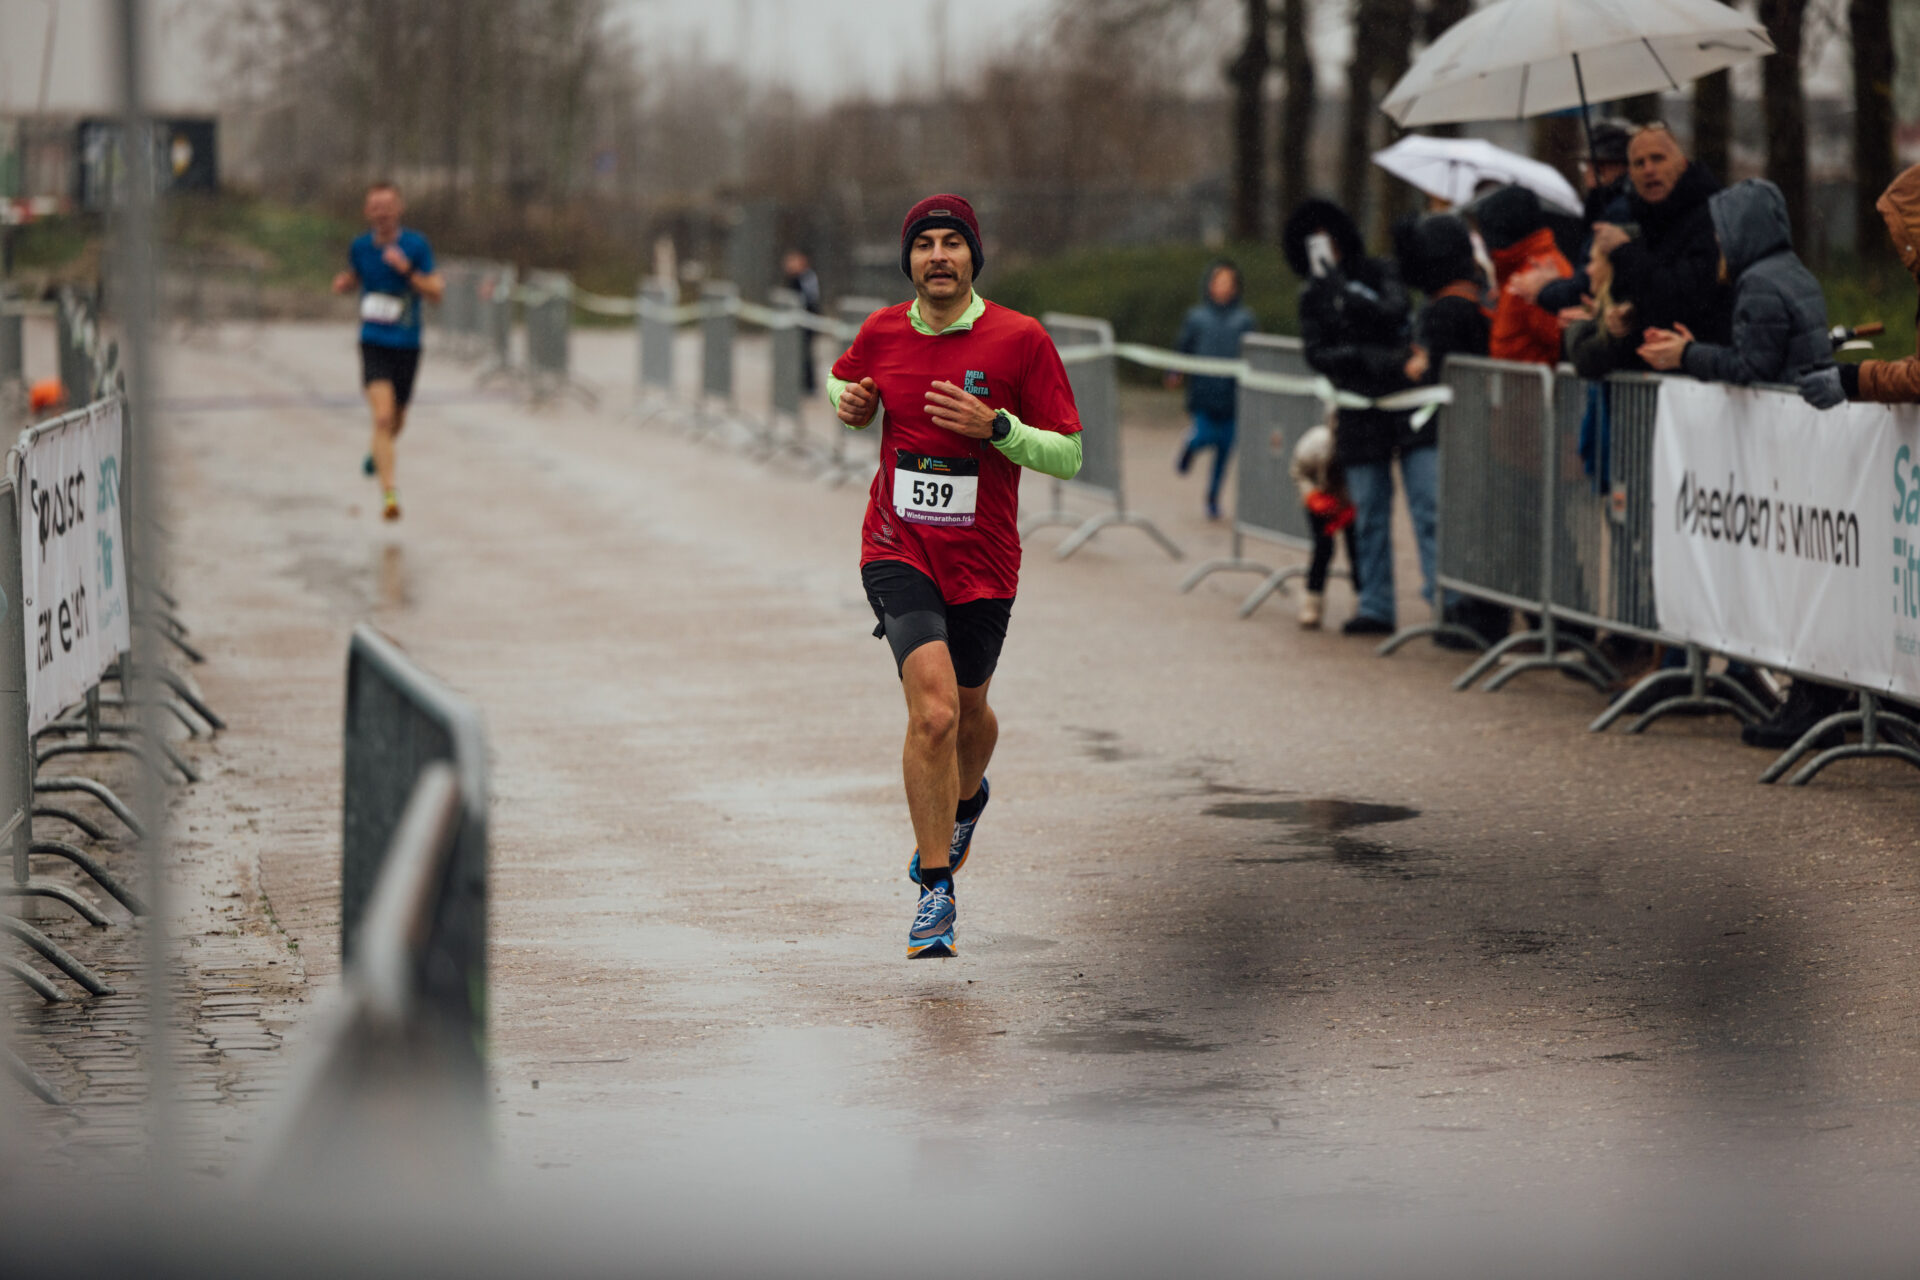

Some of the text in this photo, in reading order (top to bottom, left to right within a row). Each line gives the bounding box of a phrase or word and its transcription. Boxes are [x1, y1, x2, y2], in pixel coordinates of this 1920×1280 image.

[966, 369, 985, 380] MEIA
[965, 378, 975, 386] DE
[964, 385, 989, 396] CURITA
[912, 480, 954, 508] 539
[1675, 470, 1771, 551] Meedoen
[1773, 477, 1786, 553] is
